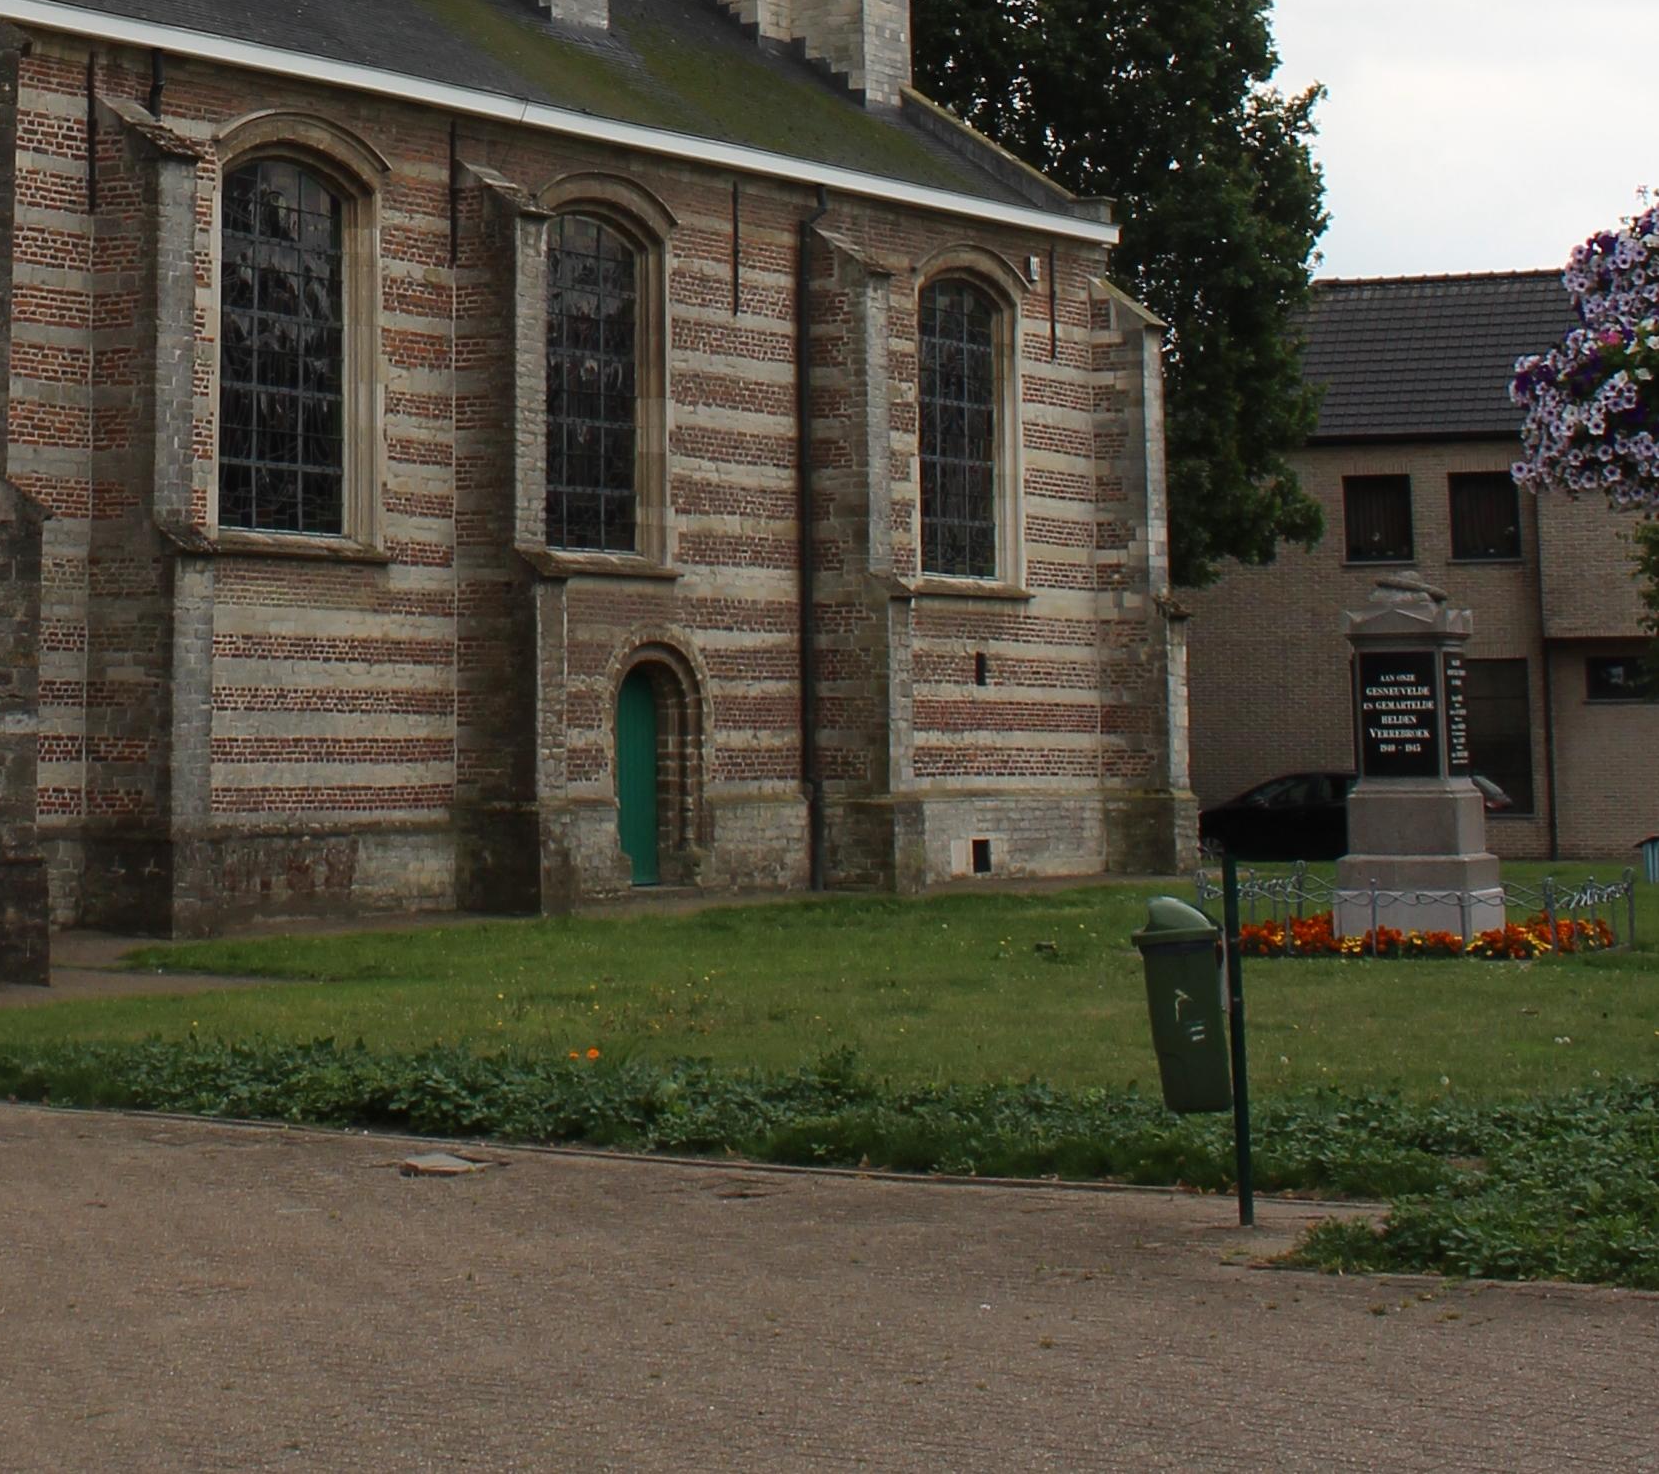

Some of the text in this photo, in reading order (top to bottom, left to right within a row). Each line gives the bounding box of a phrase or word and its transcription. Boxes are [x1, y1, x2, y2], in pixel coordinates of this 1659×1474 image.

[1380, 674, 1416, 682] AAN ONZE
[1365, 686, 1431, 696] GESNEUVELDE
[1375, 700, 1435, 710] GEMARTELDE
[1381, 715, 1417, 724] HELDEN
[1380, 744, 1395, 752] 1940
[1405, 743, 1421, 752] 1945
